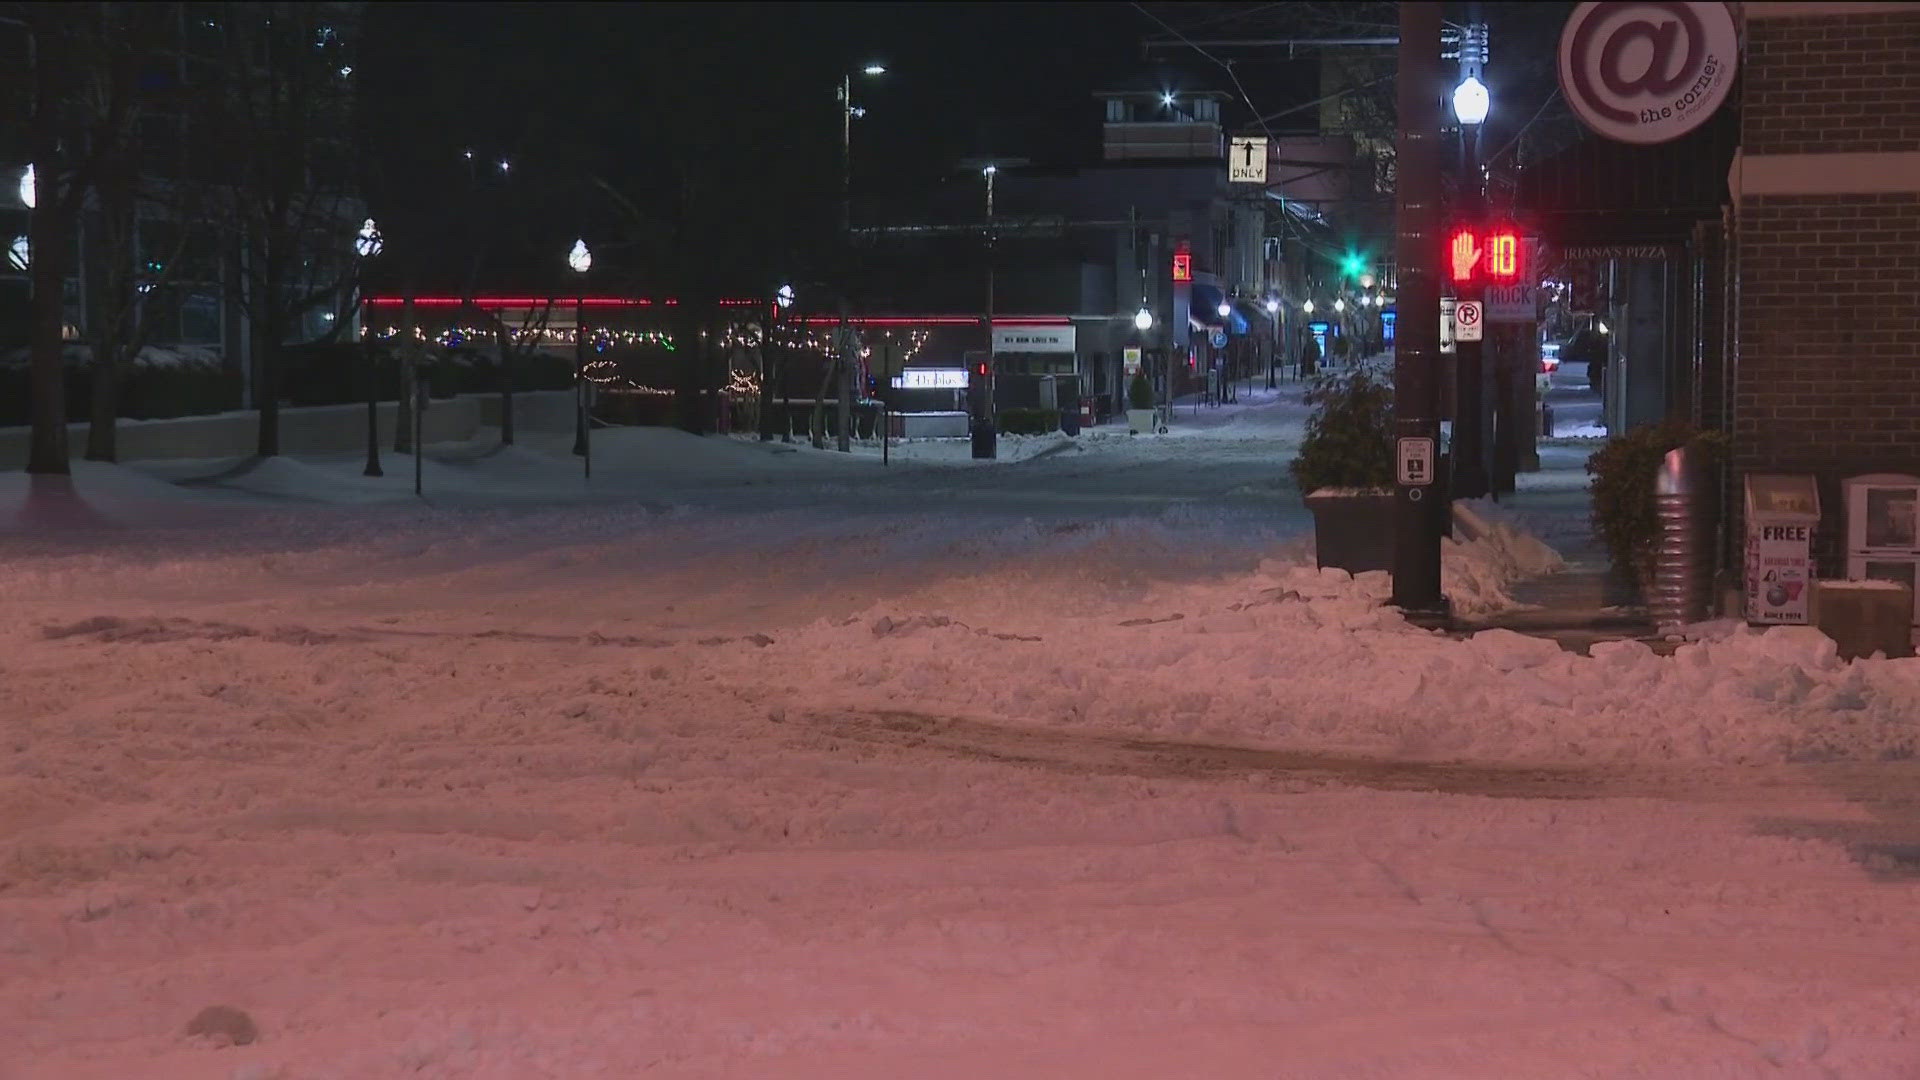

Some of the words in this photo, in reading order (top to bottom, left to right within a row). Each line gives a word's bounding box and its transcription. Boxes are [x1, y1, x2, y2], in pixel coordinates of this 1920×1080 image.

[1570, 2, 1703, 124] @
[1640, 106, 1672, 124] the
[1675, 54, 1718, 111] corner
[1233, 168, 1262, 178] ONLY
[1492, 235, 1515, 274] 10
[1626, 246, 1667, 258] PIZZA
[1490, 286, 1531, 304] ROCK
[1763, 527, 1806, 541] FREE
